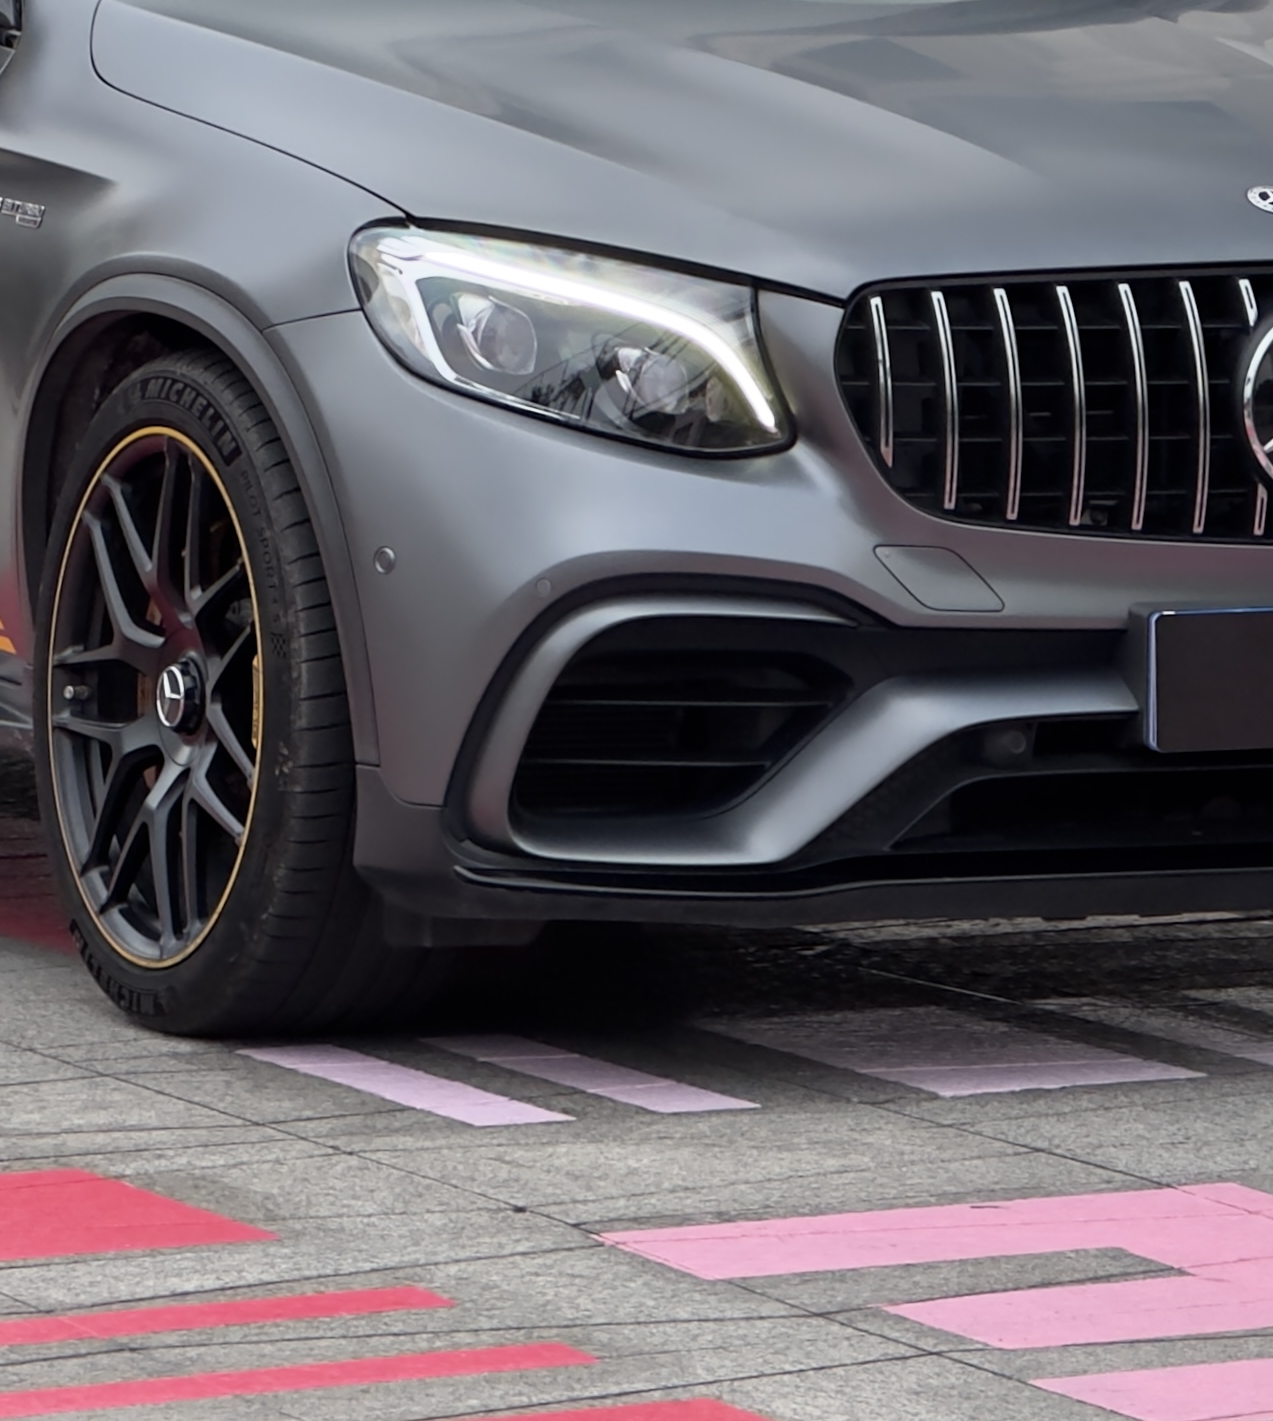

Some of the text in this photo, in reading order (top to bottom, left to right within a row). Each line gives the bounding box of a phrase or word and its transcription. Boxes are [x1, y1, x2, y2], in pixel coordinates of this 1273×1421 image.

[144, 378, 237, 458] MICHELIN
[240, 469, 262, 517] PILOT
[258, 526, 277, 589] SPORT
